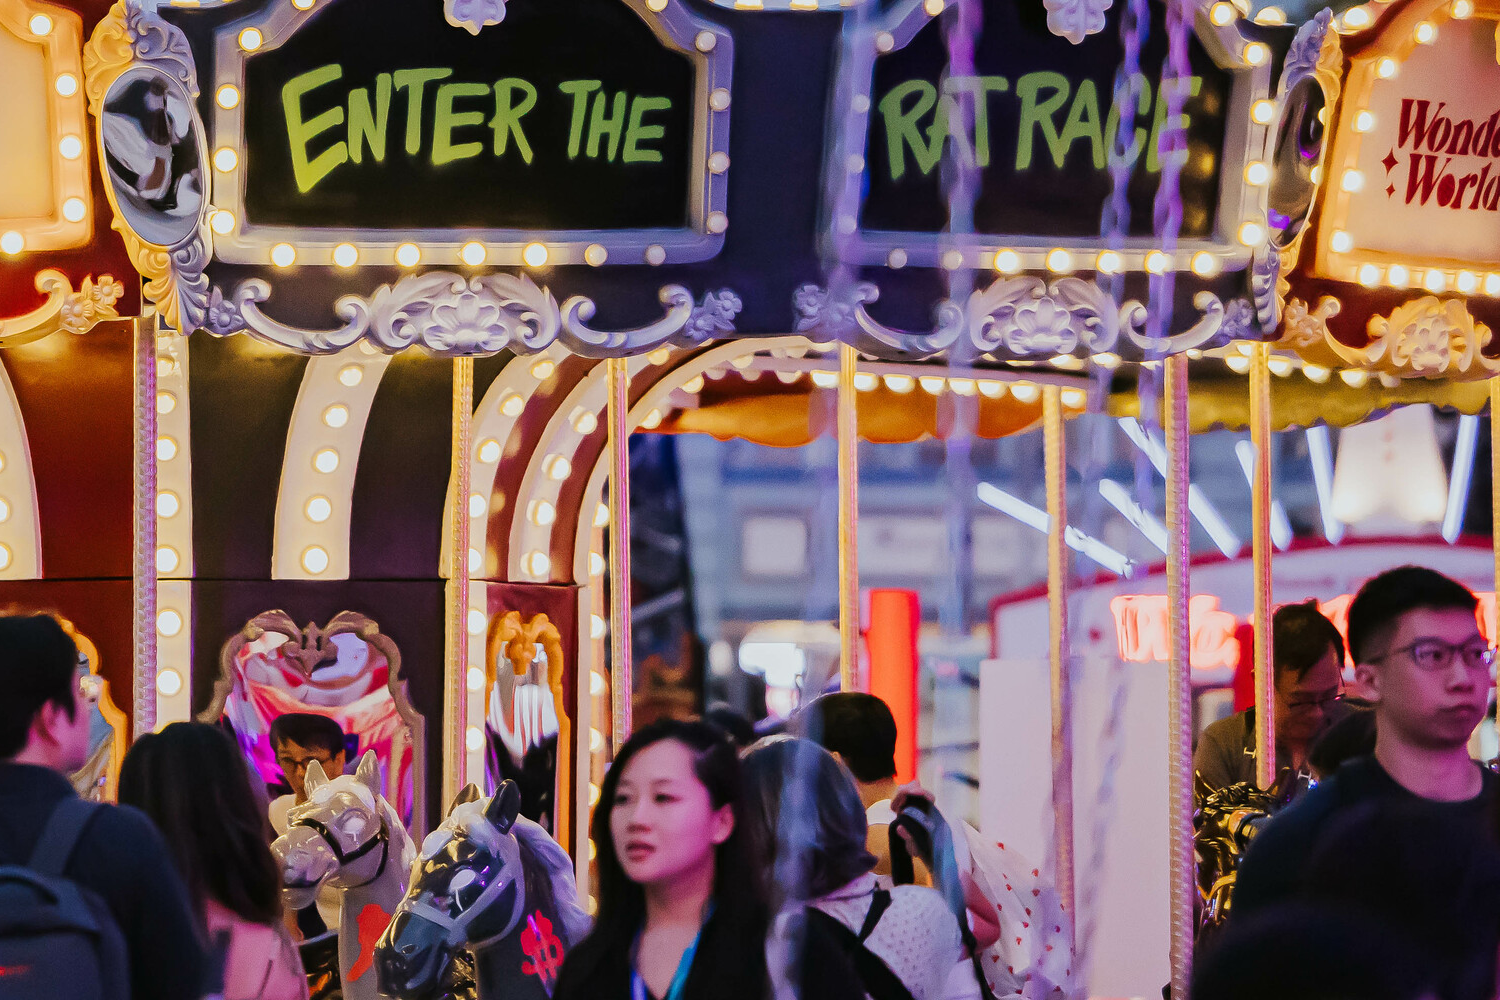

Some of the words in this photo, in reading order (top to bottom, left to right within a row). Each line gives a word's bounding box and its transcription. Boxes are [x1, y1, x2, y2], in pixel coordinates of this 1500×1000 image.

[281, 63, 538, 193] ENTER
[558, 79, 672, 163] THE
[878, 75, 1009, 180] RAT
[1015, 70, 1203, 173] RACE
